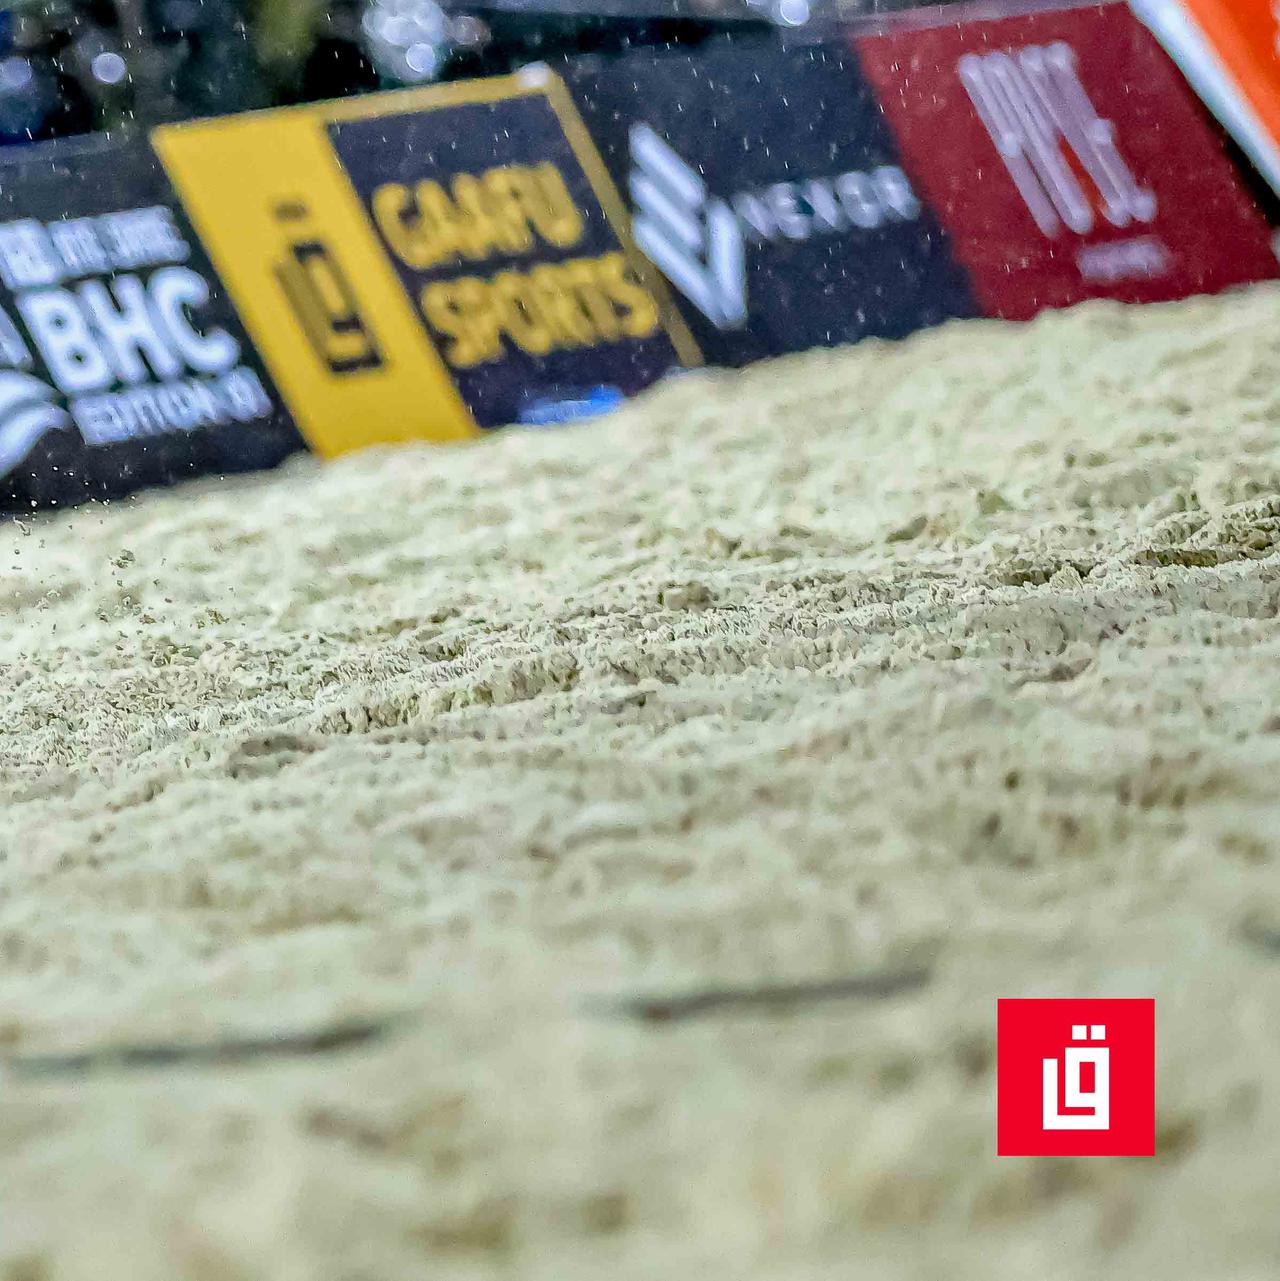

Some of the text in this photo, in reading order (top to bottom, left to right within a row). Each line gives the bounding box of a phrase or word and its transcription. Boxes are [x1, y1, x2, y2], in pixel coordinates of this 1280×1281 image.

[371, 160, 583, 270] GAAFU
[14, 265, 241, 396] BHC
[419, 250, 658, 368] SPORTS
